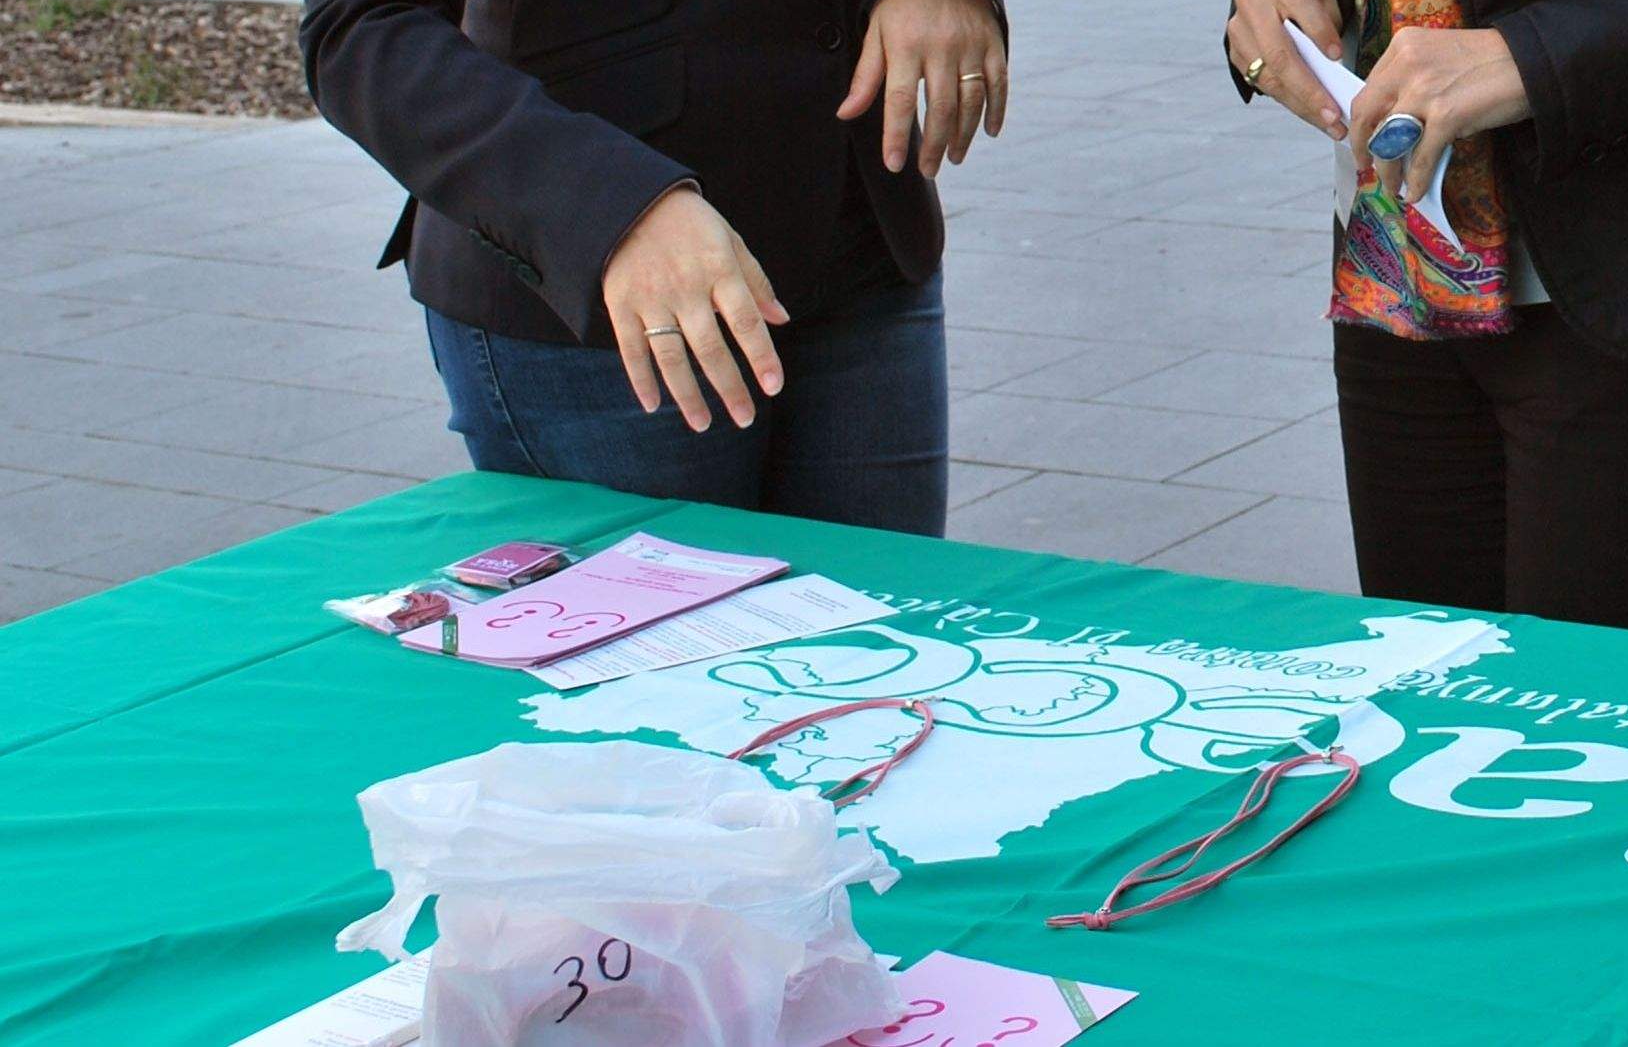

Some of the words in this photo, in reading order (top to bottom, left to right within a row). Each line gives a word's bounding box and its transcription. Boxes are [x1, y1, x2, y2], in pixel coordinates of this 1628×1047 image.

[1047, 626, 1131, 648] el
[1147, 638, 1368, 681] contra
[552, 937, 632, 1024] 30
